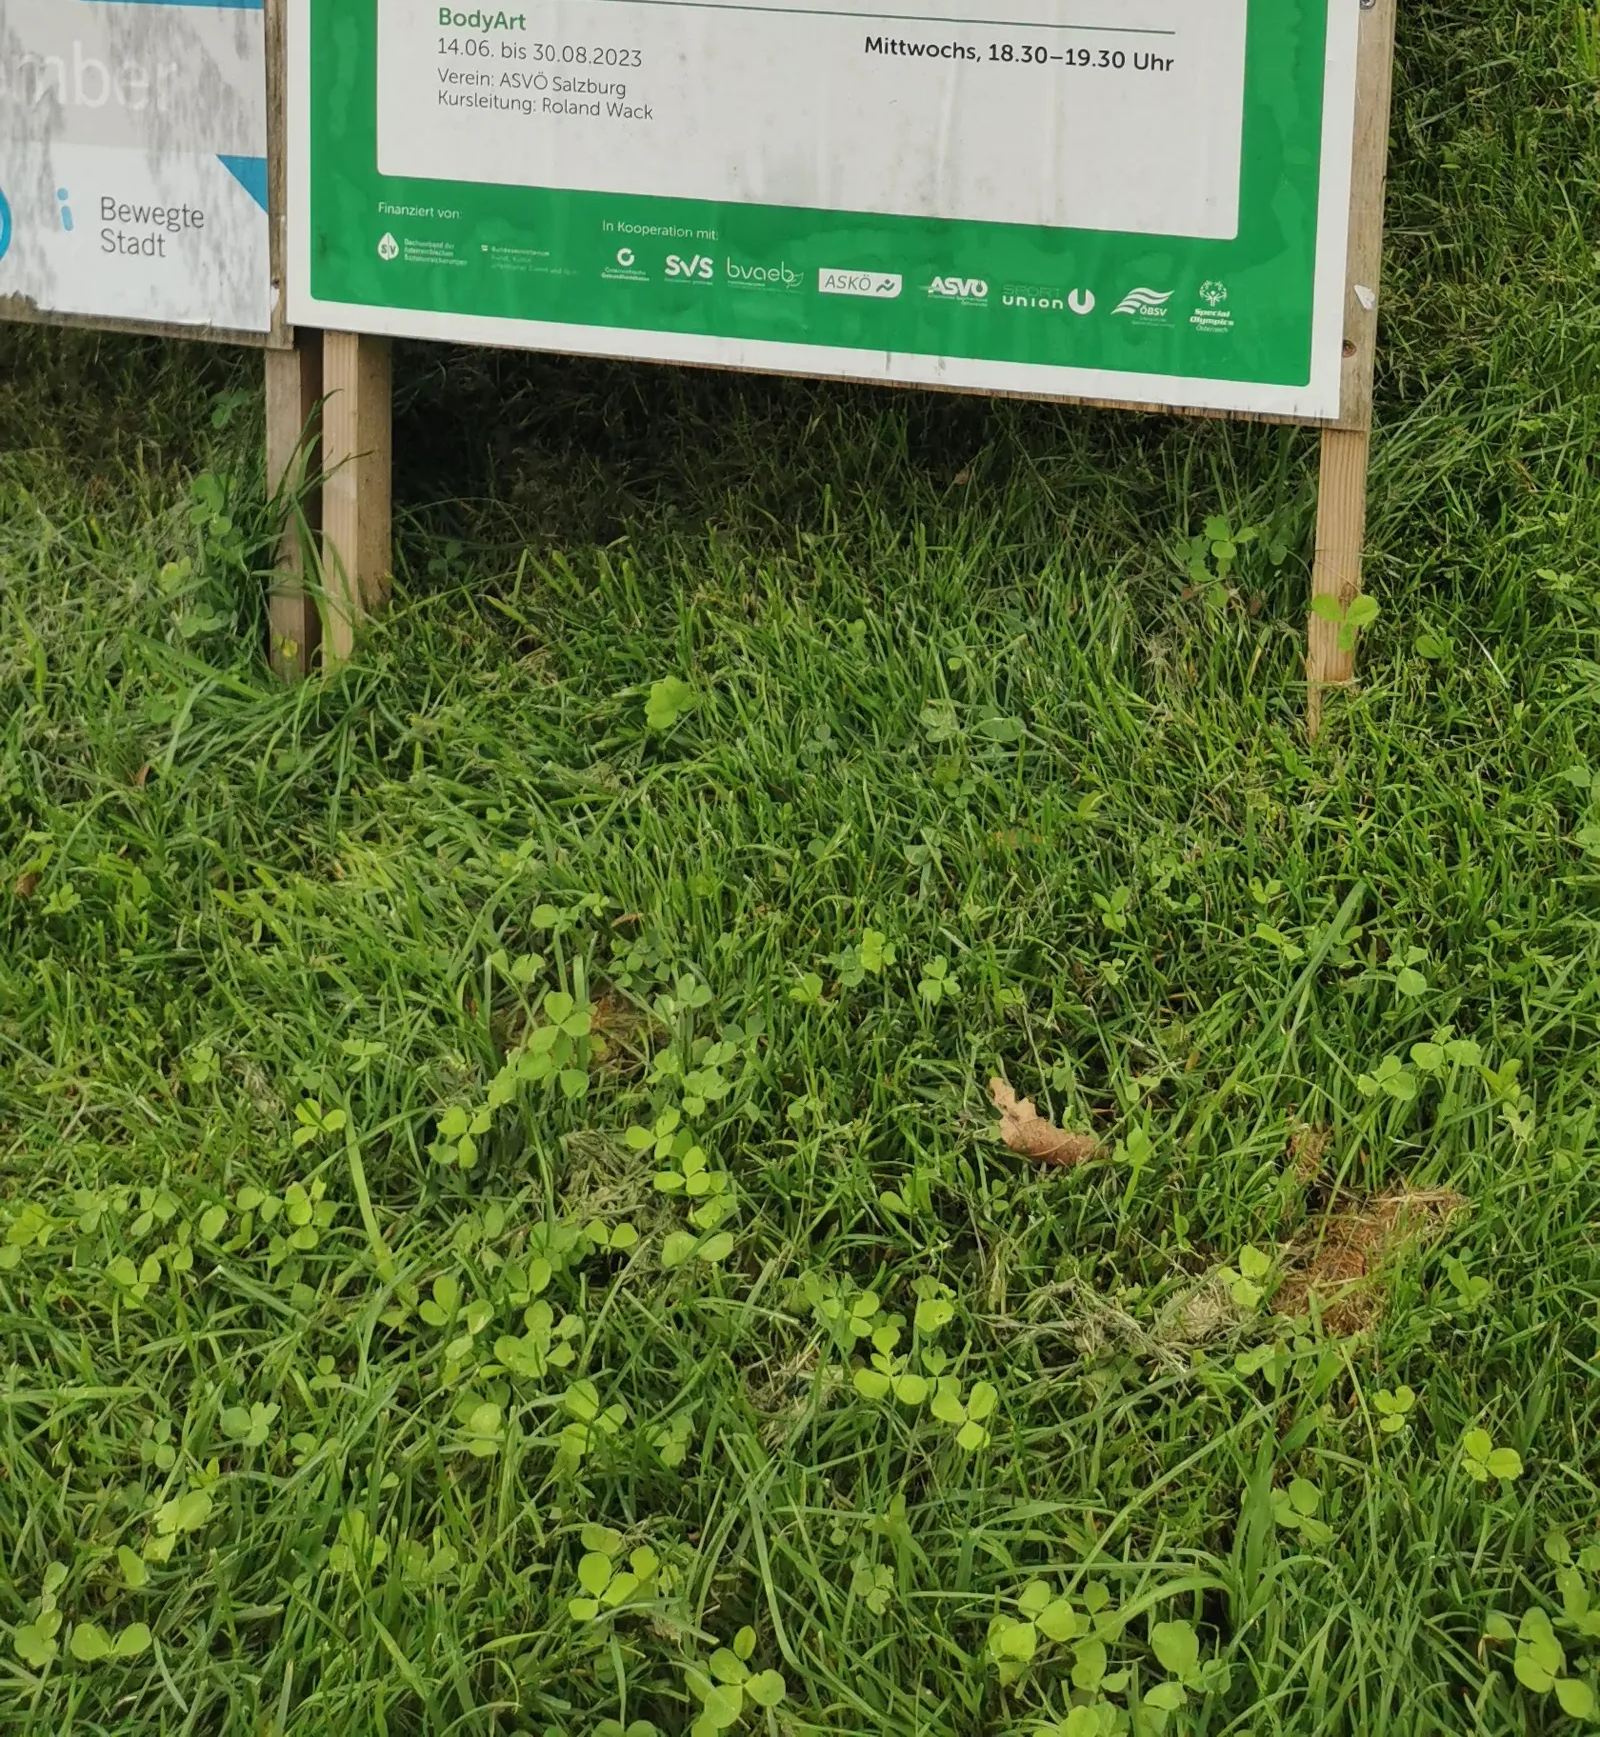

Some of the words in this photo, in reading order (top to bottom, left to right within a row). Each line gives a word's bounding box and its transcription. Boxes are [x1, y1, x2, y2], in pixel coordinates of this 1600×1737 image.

[438, 7, 527, 33] BodyArt
[437, 37, 496, 59] 14.06.
[500, 42, 528, 62] bis
[532, 43, 643, 69] 30.08.2023
[864, 35, 982, 63] Mittwochs,
[1133, 51, 1176, 73] Uhr
[437, 67, 496, 89] Verein:
[499, 71, 549, 92] ASVÖ
[552, 74, 628, 100] Salzburg
[437, 91, 538, 115] Kursleitung:
[542, 97, 601, 118] Roland
[606, 102, 655, 122] Wack
[100, 195, 205, 232] Bewegte
[378, 201, 435, 218] Finanziert
[100, 227, 166, 258] Stadt
[602, 219, 615, 233] In
[617, 221, 694, 238] Kooperation
[696, 228, 719, 241] mit:
[664, 253, 715, 279] SVS
[726, 256, 795, 283] bvaeb
[825, 273, 872, 292] ASKÖ
[928, 276, 989, 298] ASVÖ
[1002, 294, 1064, 310] union
[1140, 305, 1168, 316] ÖBSV
[1194, 307, 1231, 318] Special
